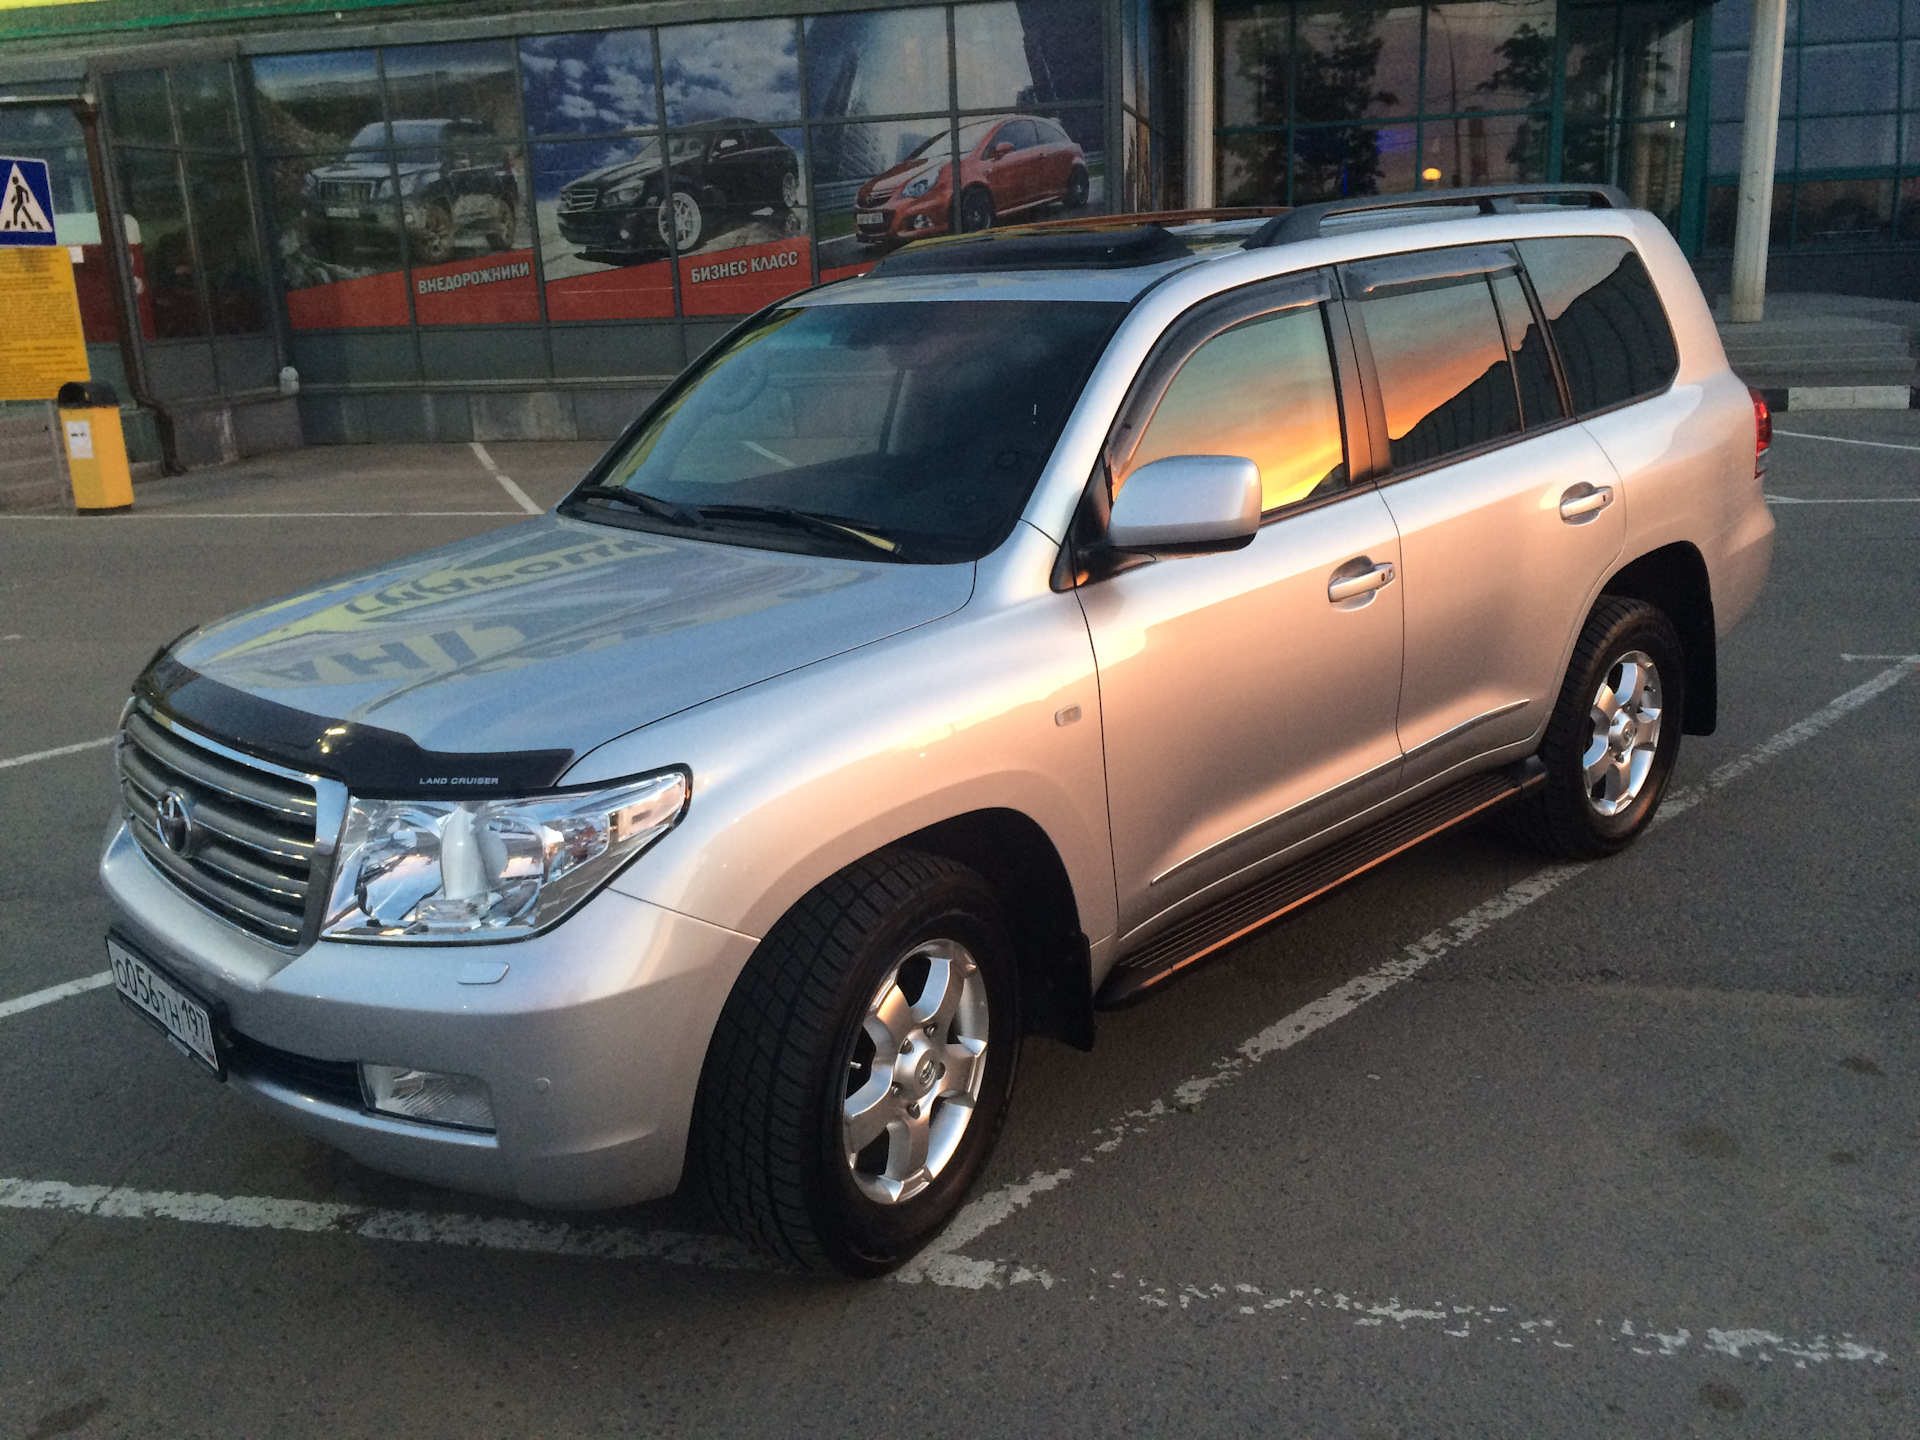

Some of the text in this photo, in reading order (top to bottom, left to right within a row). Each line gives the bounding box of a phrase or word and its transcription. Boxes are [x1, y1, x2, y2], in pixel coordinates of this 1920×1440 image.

[418, 261, 530, 295] ВНЕДОРОЖНИКИ
[691, 251, 798, 284] БИЗНЕС КЛАСС
[419, 777, 499, 785] LAND CRUISER
